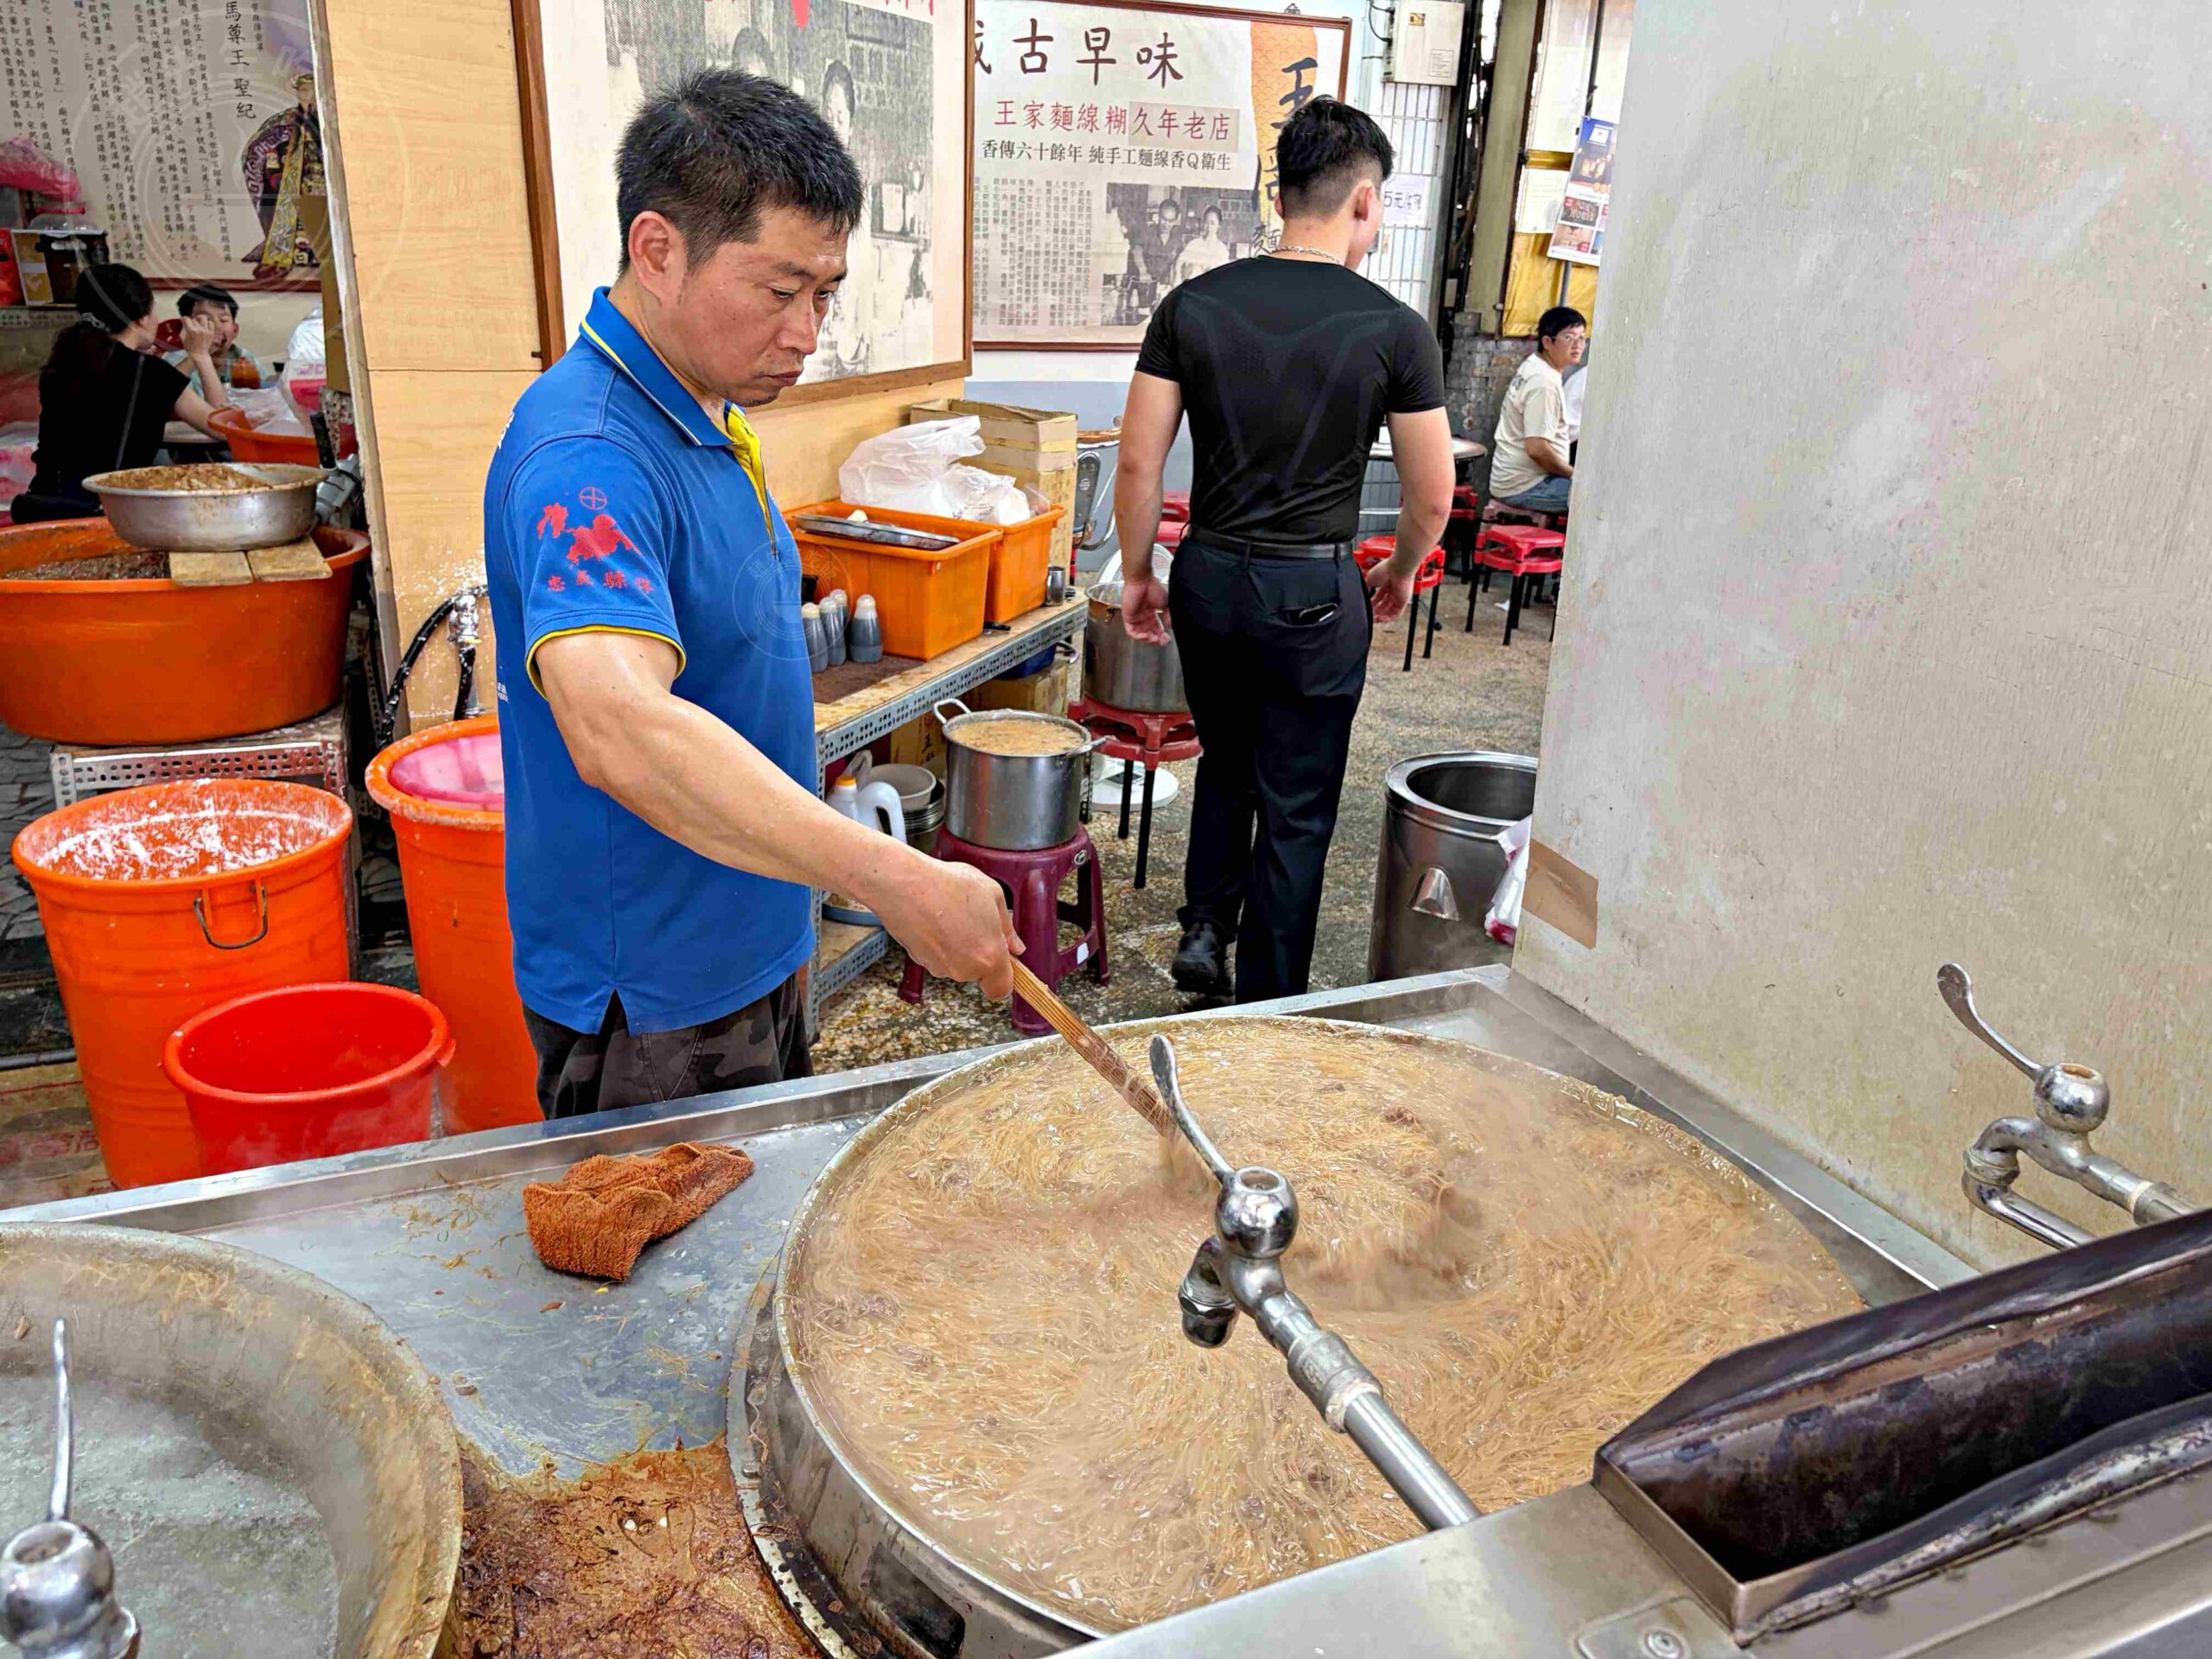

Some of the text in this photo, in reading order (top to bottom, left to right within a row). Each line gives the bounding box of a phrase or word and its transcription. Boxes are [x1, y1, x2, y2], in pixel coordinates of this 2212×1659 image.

[994, 100, 1230, 141] 王家麵線糊久年老店
